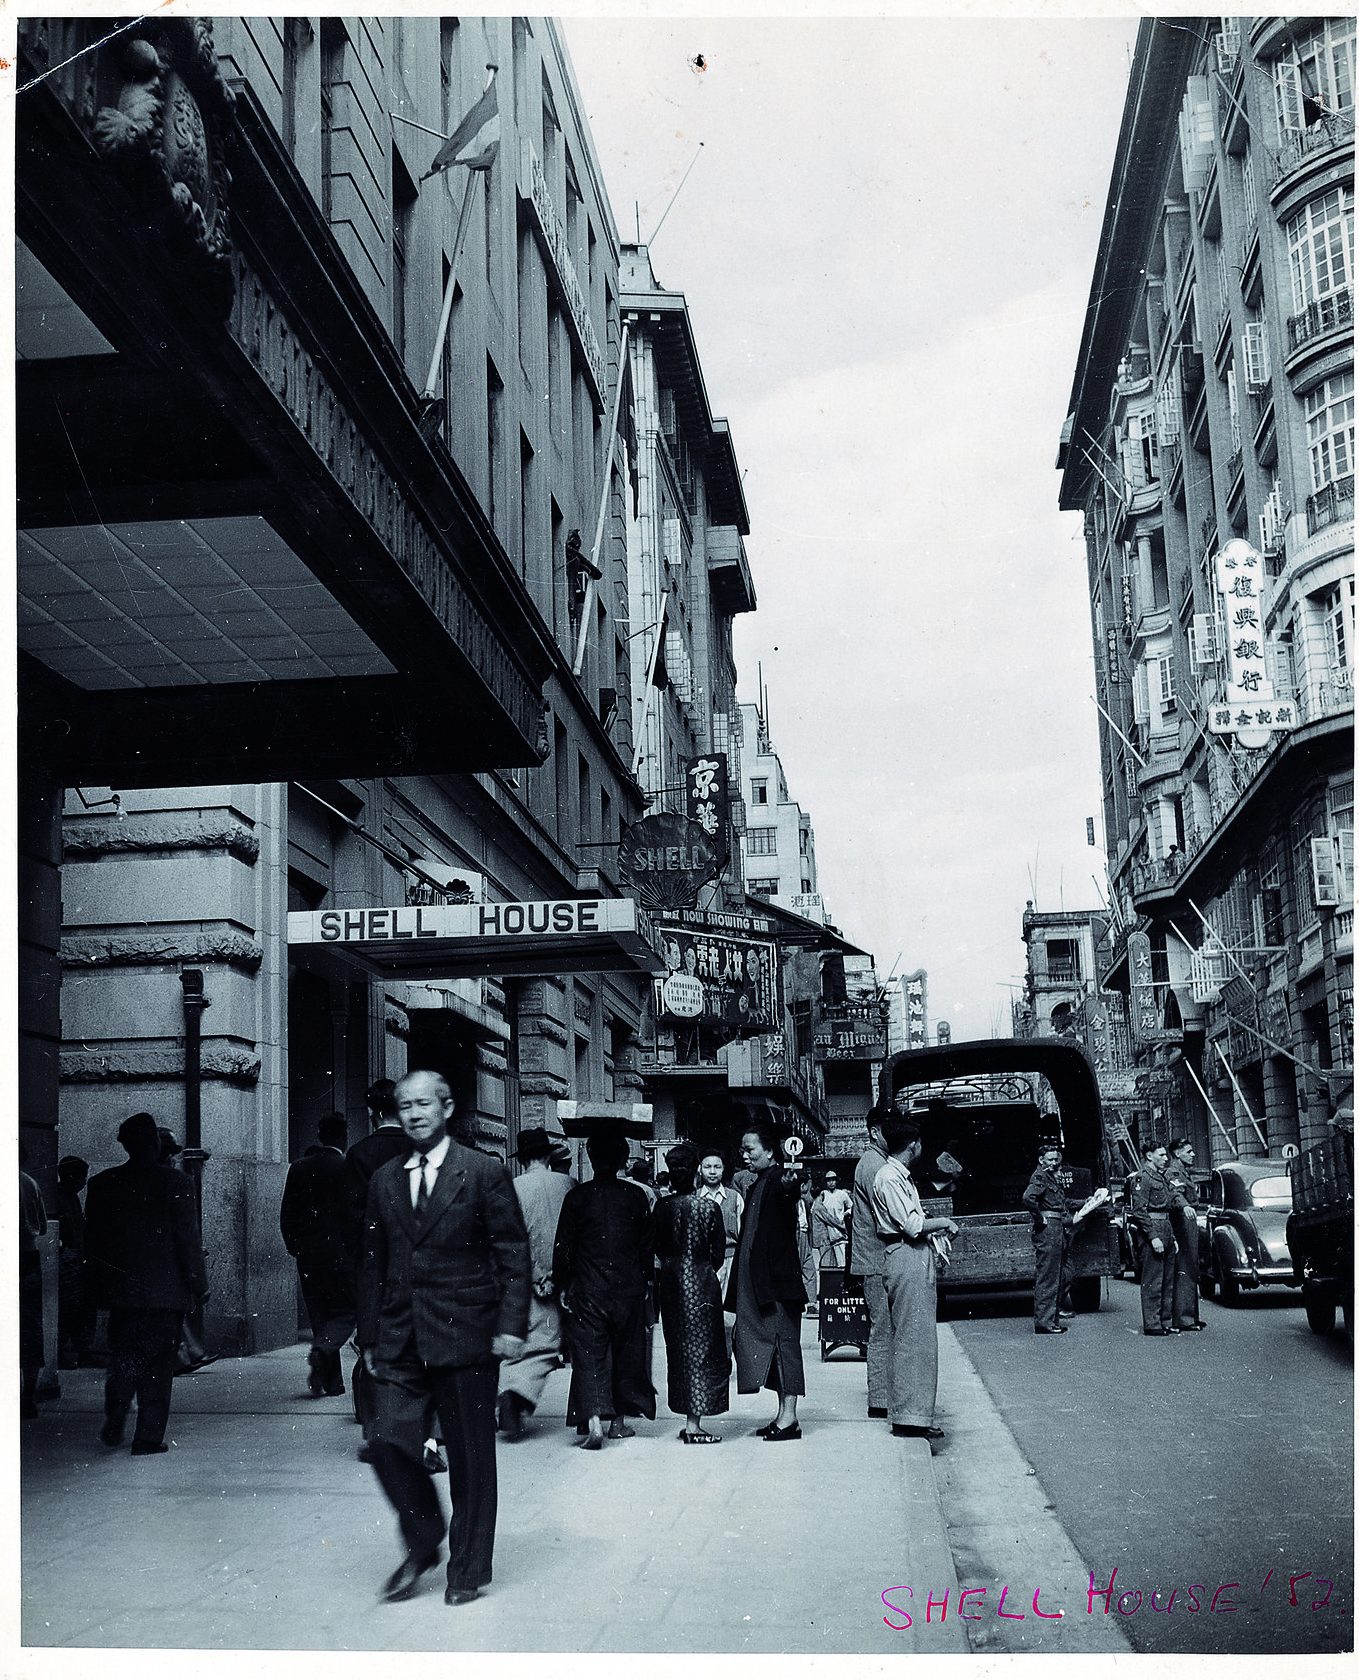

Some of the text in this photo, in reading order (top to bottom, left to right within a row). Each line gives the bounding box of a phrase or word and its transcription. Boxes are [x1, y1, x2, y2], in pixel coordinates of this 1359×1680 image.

[634, 846, 705, 871] SHELL
[320, 907, 437, 941] SHELL
[478, 901, 599, 935] HOUSE
[683, 909, 704, 923] NOW
[707, 912, 751, 930] SHOWING
[825, 1047, 856, 1059] Beer
[842, 1297, 865, 1305] LITTE
[837, 1306, 857, 1314] ONLY
